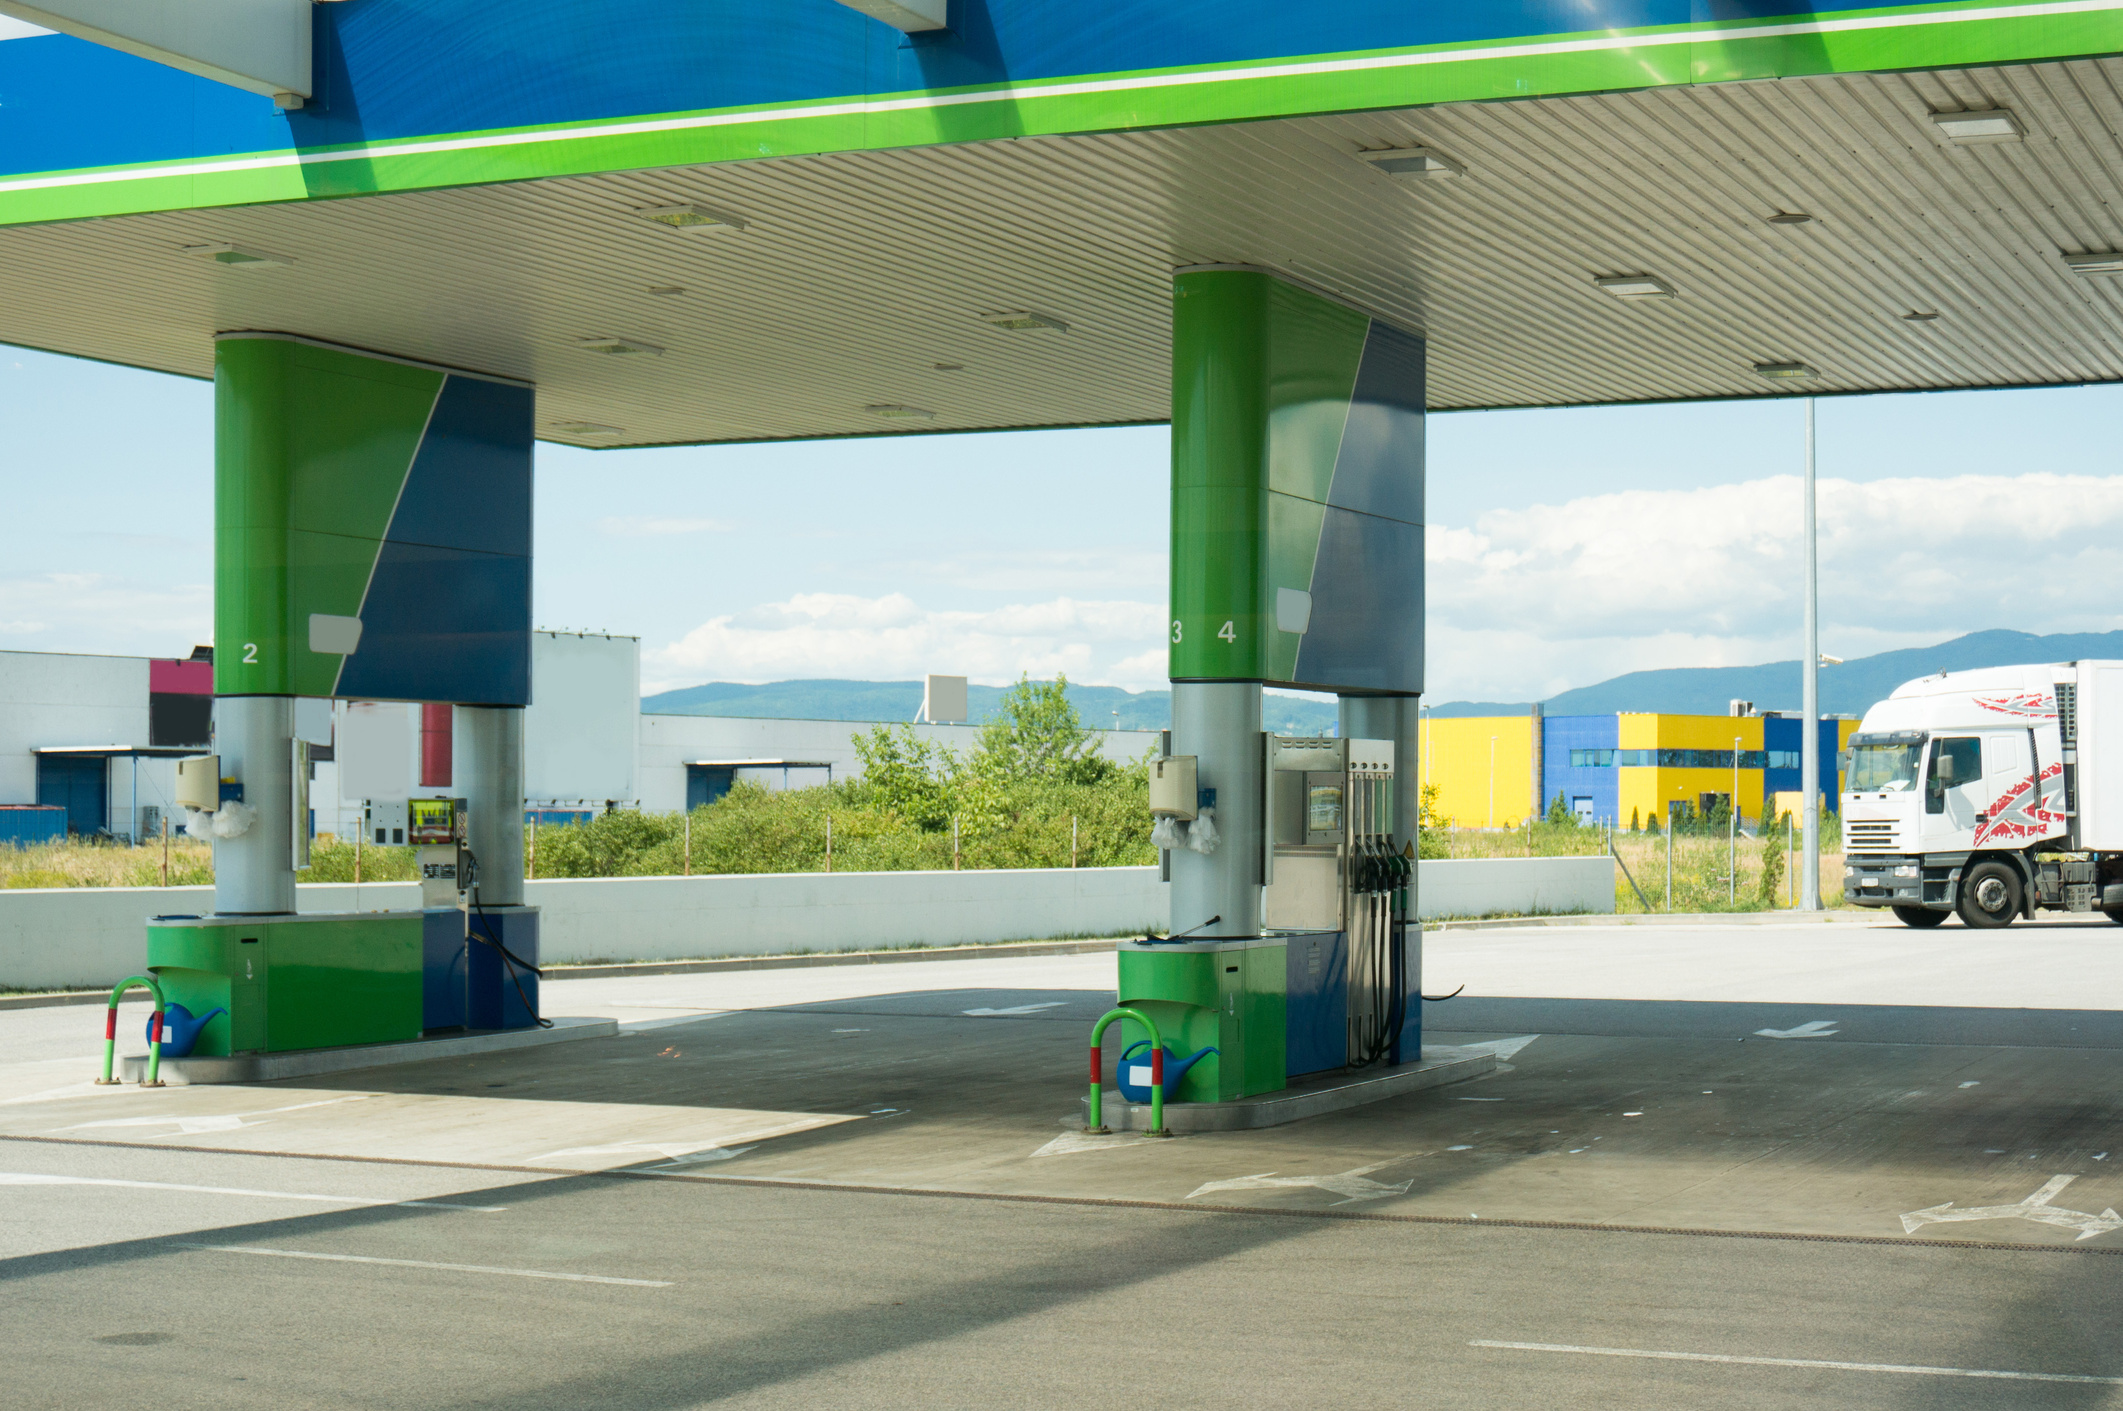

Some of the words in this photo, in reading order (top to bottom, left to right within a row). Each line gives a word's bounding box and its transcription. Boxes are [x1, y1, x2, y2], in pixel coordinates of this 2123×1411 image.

[1172, 620, 1182, 644] 3
[1218, 620, 1236, 644] 4
[243, 643, 258, 664] 2
